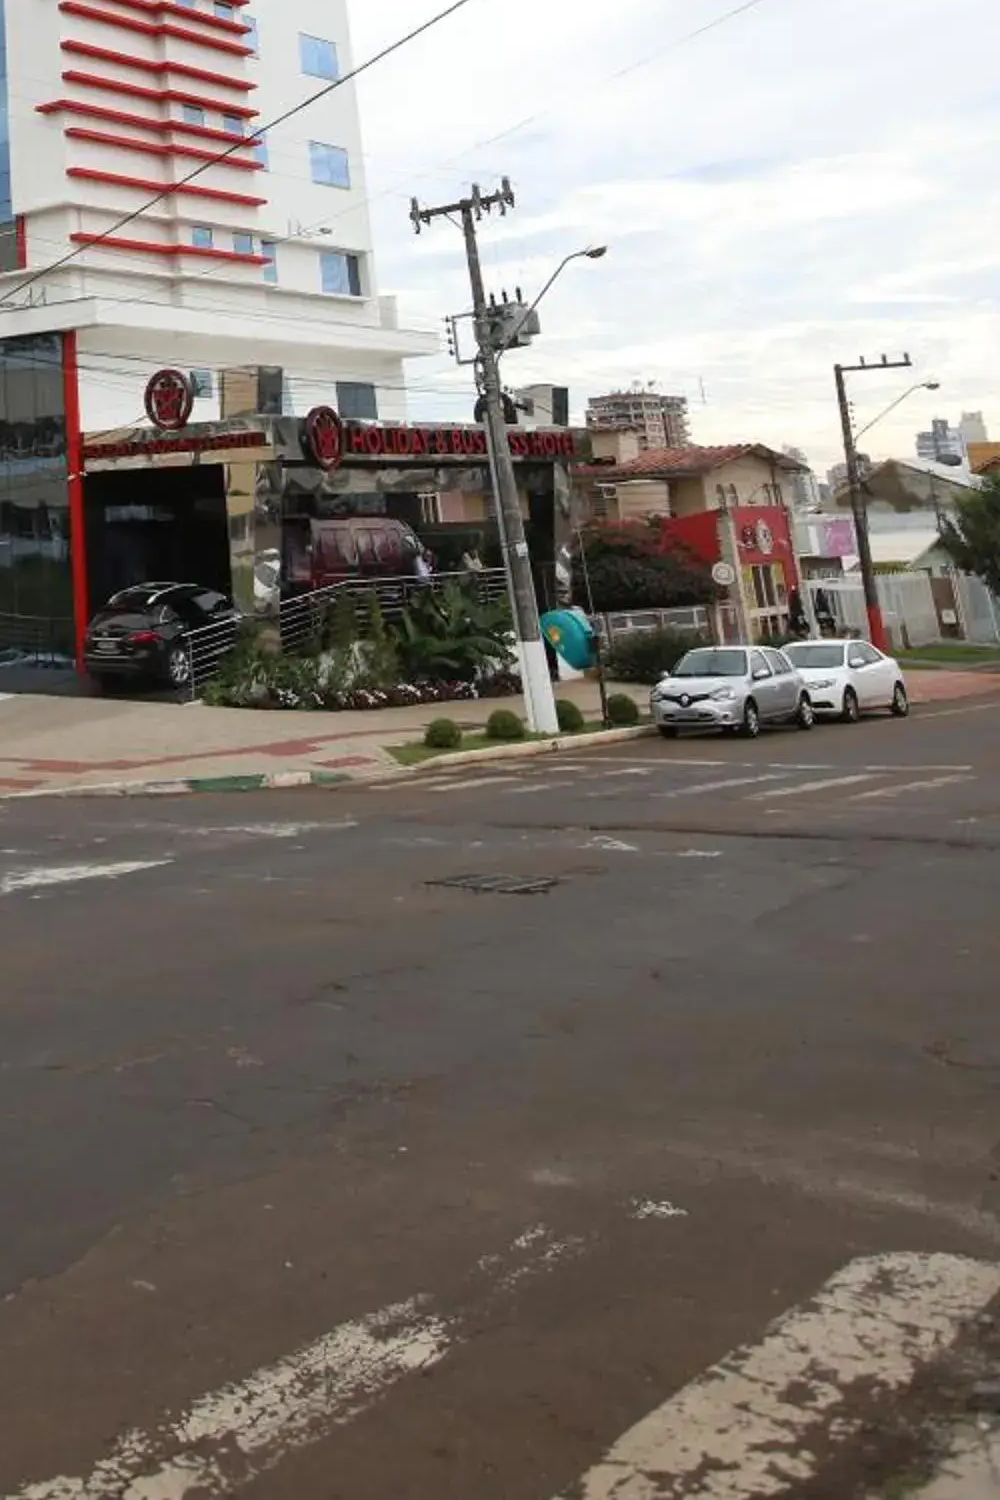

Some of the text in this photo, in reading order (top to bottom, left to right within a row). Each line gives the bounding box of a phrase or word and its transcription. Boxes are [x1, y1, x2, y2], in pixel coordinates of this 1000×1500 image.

[351, 425, 430, 454] HOLIDAY
[434, 425, 449, 453] &
[451, 425, 530, 455] BUSSS
